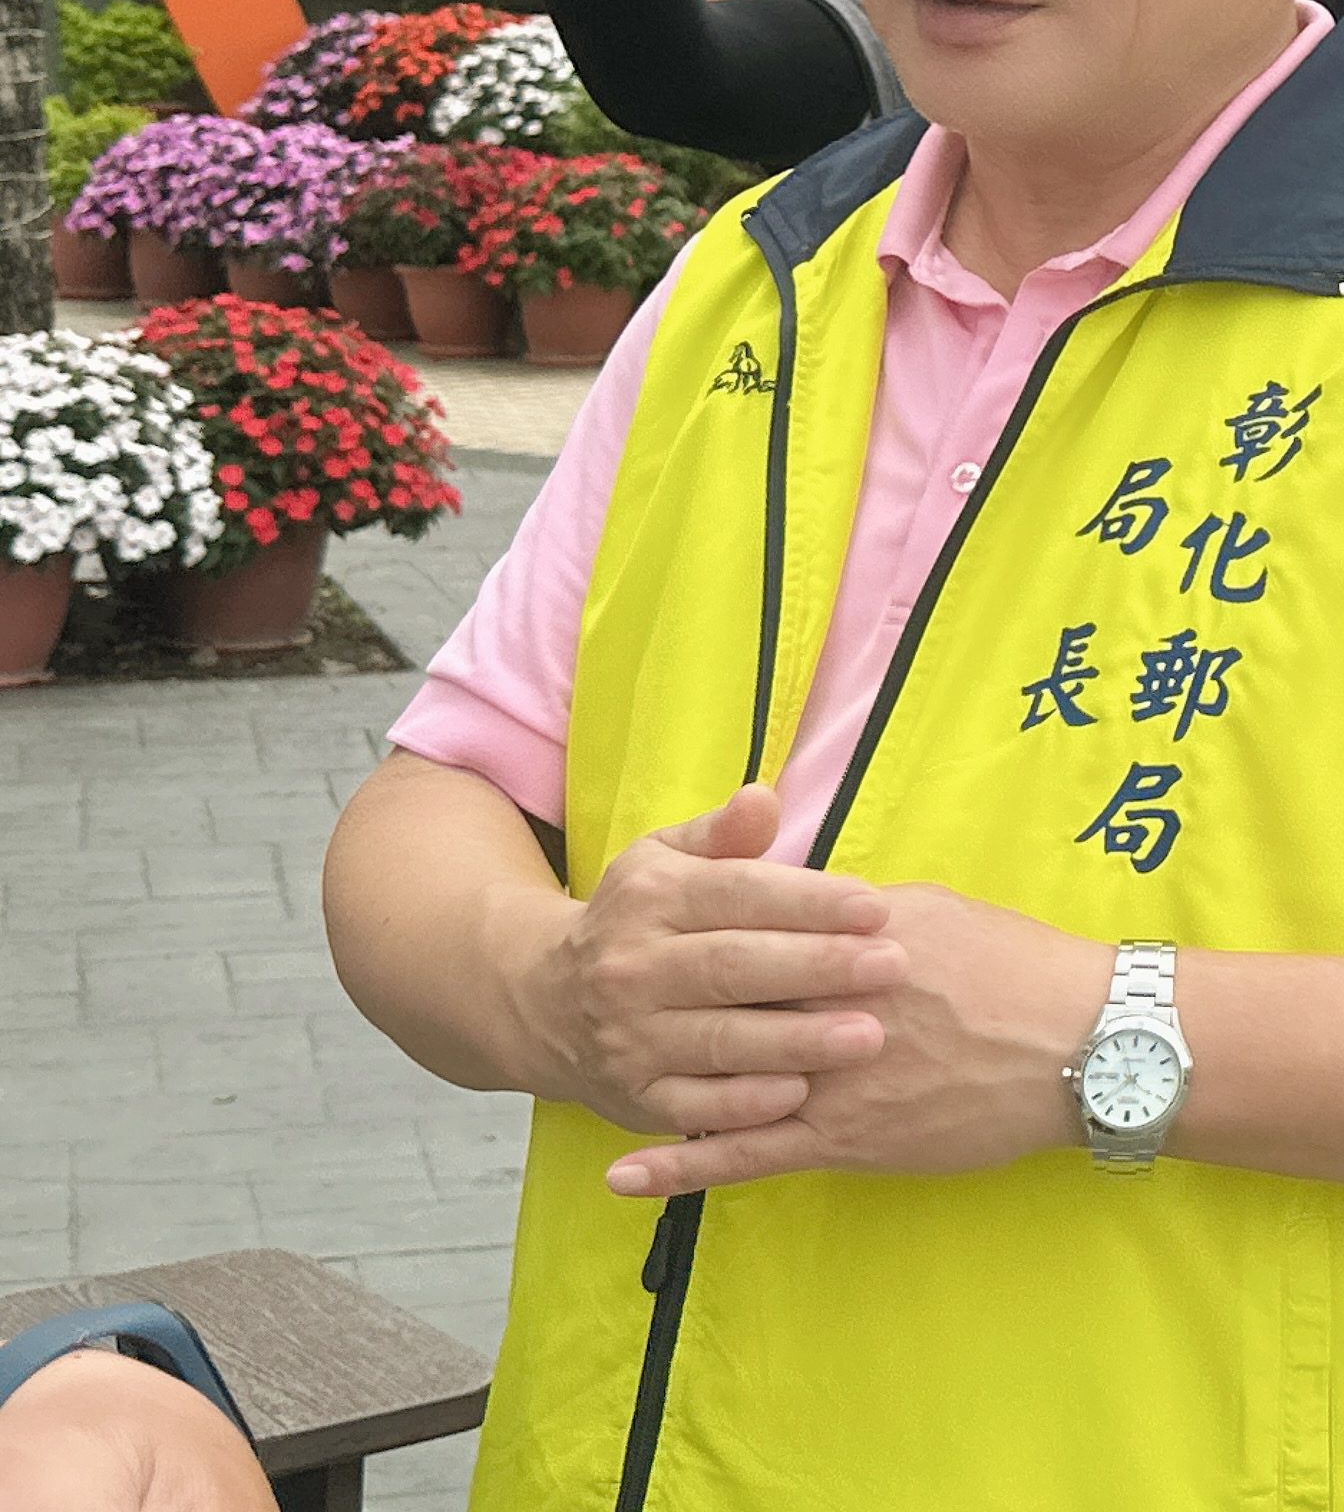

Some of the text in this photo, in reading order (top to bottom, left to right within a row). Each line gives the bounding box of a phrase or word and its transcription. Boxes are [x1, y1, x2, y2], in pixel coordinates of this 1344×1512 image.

[1019, 456, 1173, 733] 局長
[1074, 378, 1324, 874] 彰化郵局
